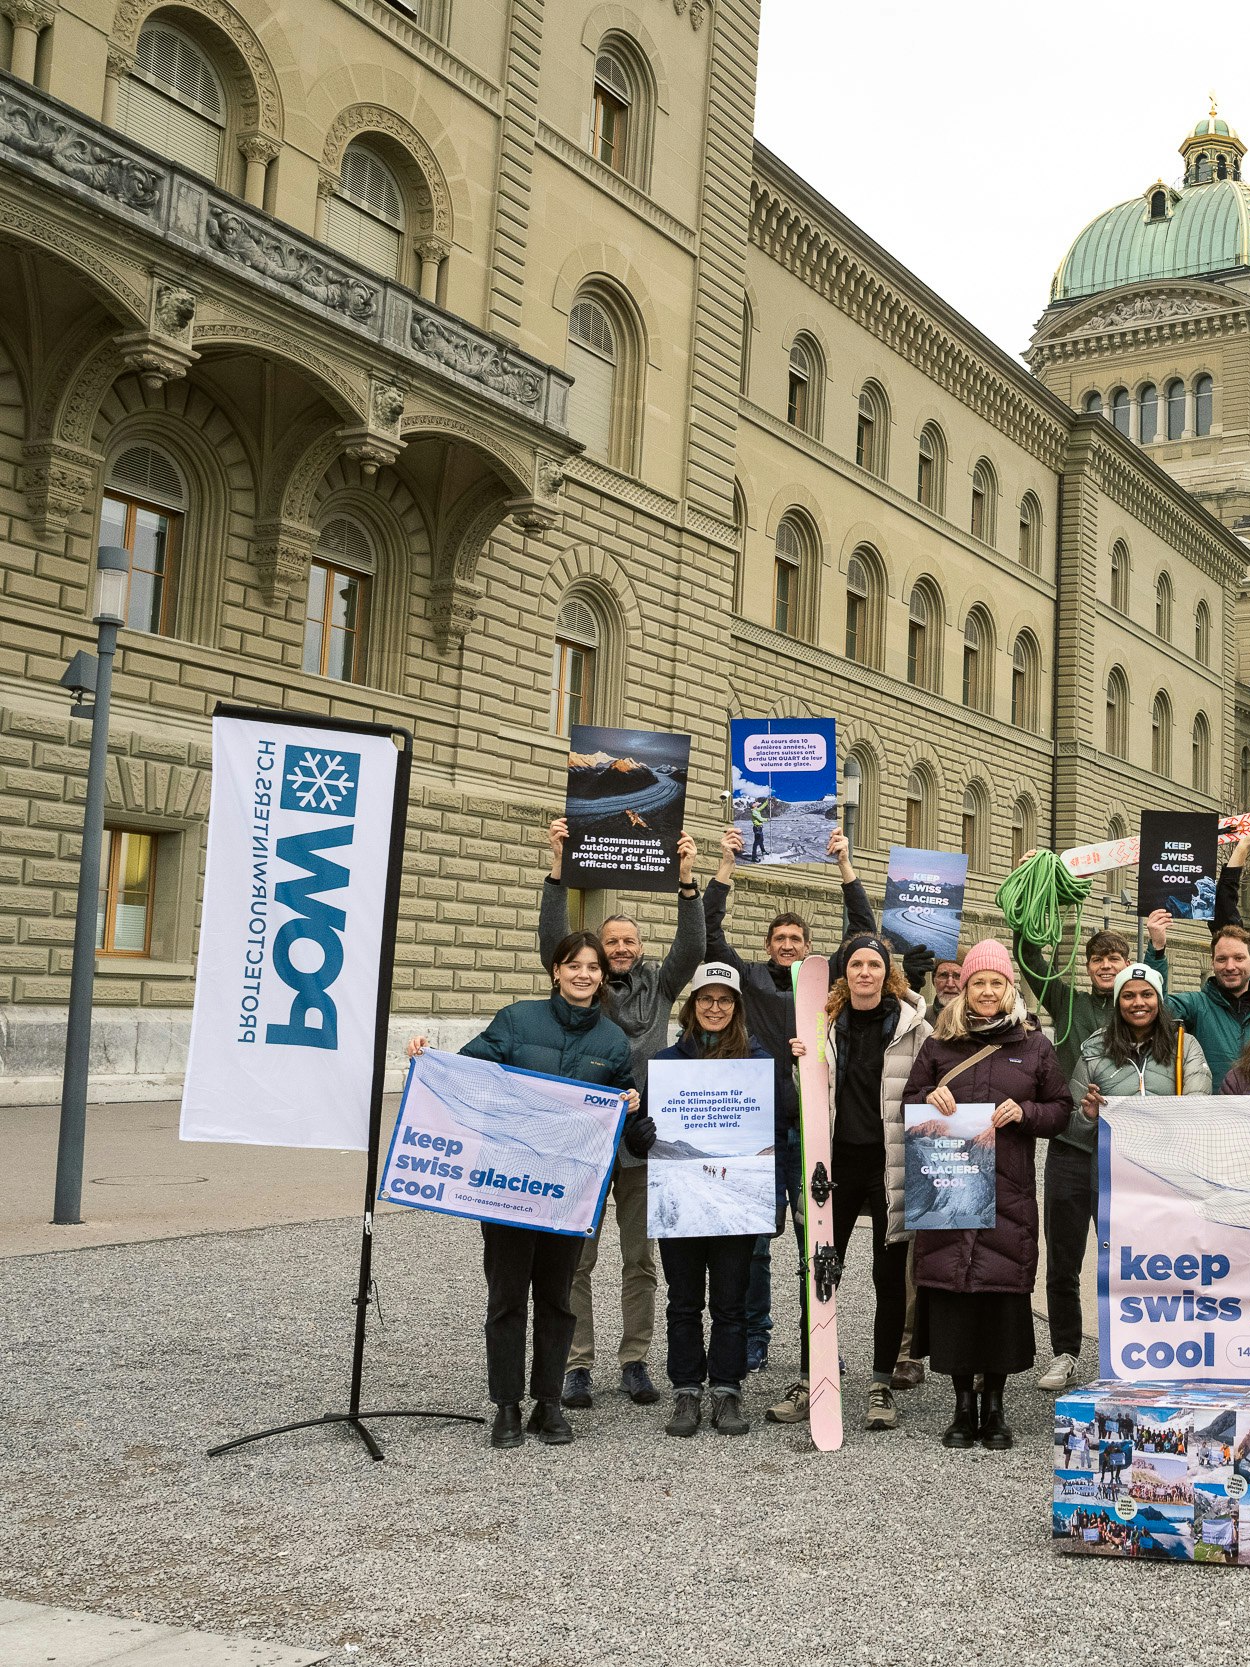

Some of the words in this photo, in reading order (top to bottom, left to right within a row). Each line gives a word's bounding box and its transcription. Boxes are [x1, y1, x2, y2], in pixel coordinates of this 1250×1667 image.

[598, 837, 661, 847] communauté
[1164, 841, 1192, 850] KEEP
[580, 843, 619, 852] outdoor
[621, 846, 644, 854] pour
[572, 851, 623, 861] protection
[625, 854, 638, 862] du
[640, 856, 670, 864] climat
[1160, 853, 1194, 862] SWISS
[579, 860, 618, 869] efficace
[634, 863, 665, 872] Suisse
[1152, 863, 1203, 873] GLACIERS
[913, 872, 940, 883] KEEP
[1162, 875, 1191, 884] COOL
[908, 884, 942, 894] SWISS
[898, 893, 949, 906] GLACIERS
[907, 905, 937, 916] COOL
[816, 1012, 826, 1063] FACTION
[584, 1094, 610, 1106] POW
[679, 1105, 760, 1113] Herausforderungen
[684, 1122, 717, 1130] gerecht
[402, 1125, 463, 1157] keep
[934, 1139, 966, 1148] KEEP
[930, 1152, 969, 1161] SWISS
[920, 1165, 980, 1175] GLACIERS
[395, 1154, 463, 1180] swiss
[468, 1168, 566, 1199] glaciers
[933, 1178, 967, 1187] COOL
[390, 1178, 445, 1201] cool
[455, 1193, 533, 1213] 1400-reasons-to-act.ch
[1120, 1246, 1230, 1286] keep
[1119, 1290, 1241, 1324] swiss
[1121, 1332, 1215, 1370] cool
